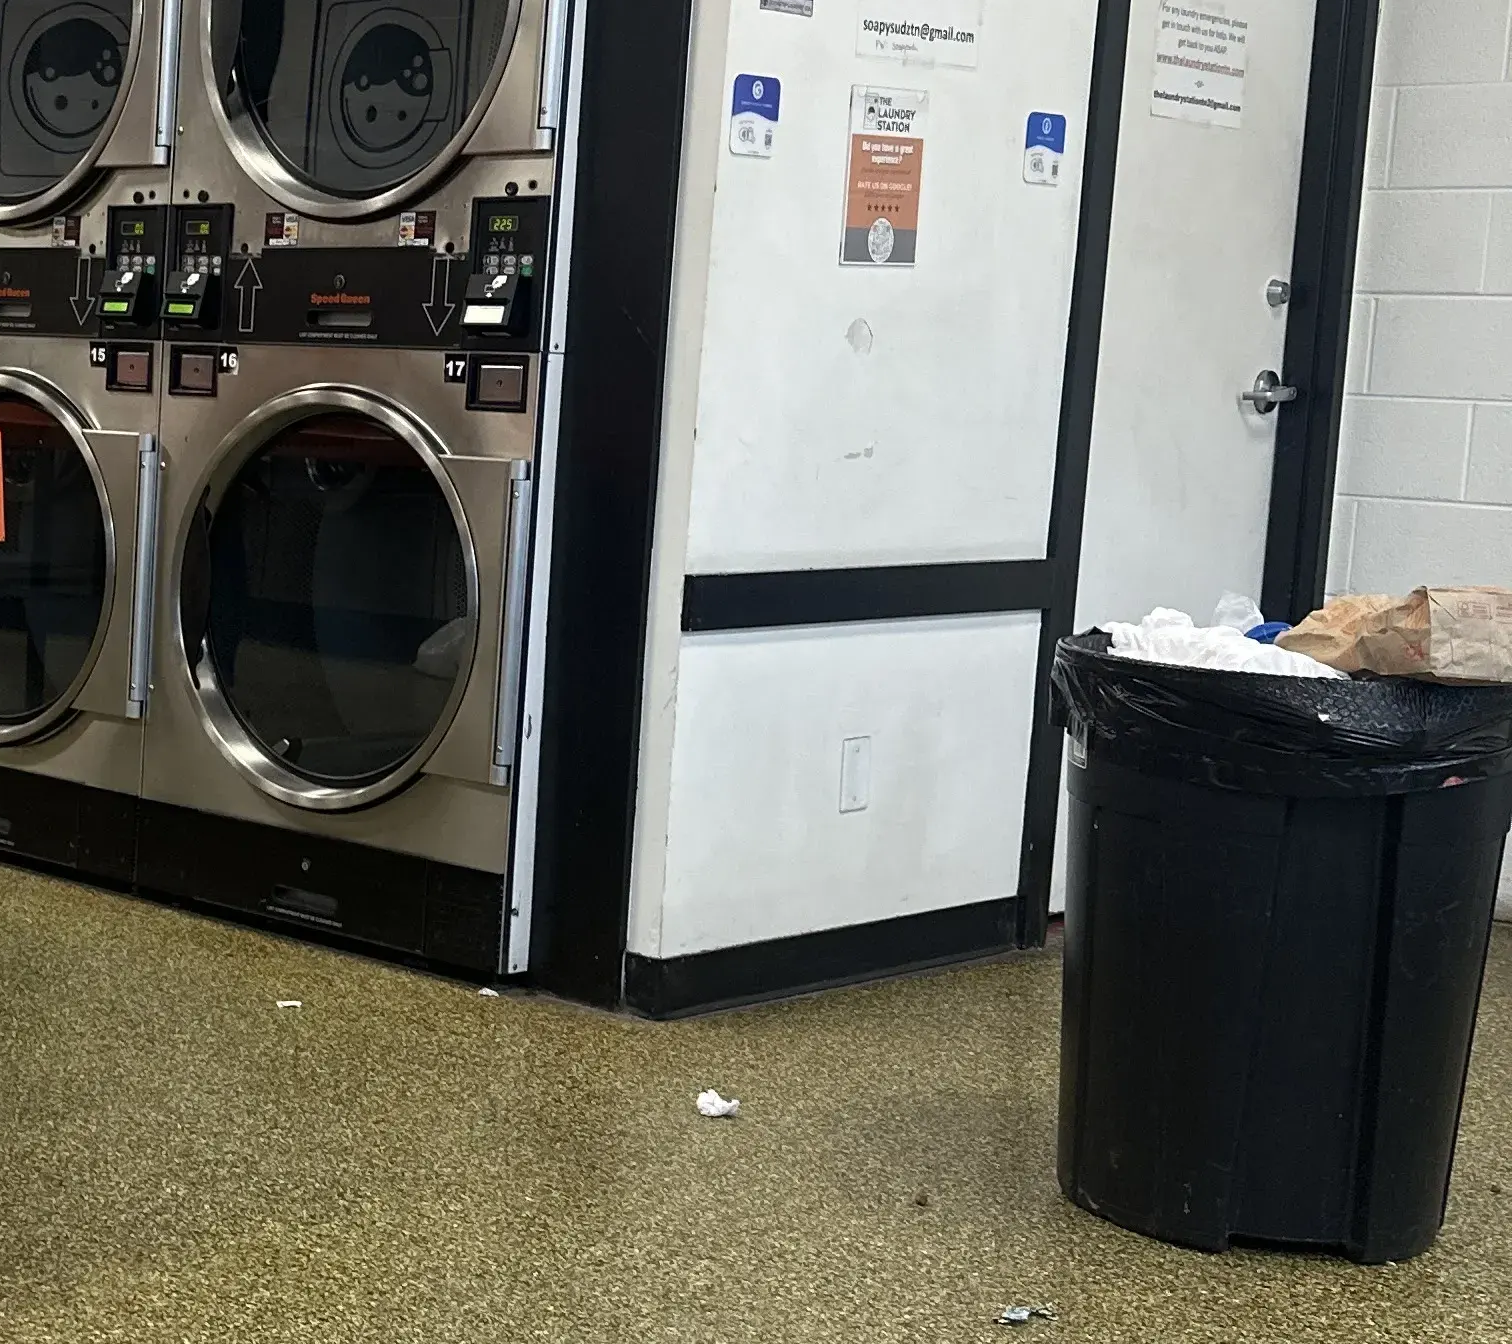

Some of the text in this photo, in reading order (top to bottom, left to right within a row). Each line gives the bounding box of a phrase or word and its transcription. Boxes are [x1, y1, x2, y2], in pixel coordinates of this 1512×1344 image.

[863, 18, 975, 44] soapysudztn@gmail.com
[879, 97, 893, 106] THE
[878, 108, 917, 121] LAUNDRY
[877, 120, 910, 133] STATION
[494, 218, 513, 231] 225
[311, 292, 340, 306] Speed
[91, 347, 106, 362] 15
[221, 353, 238, 369] 16
[446, 361, 466, 378] 17
